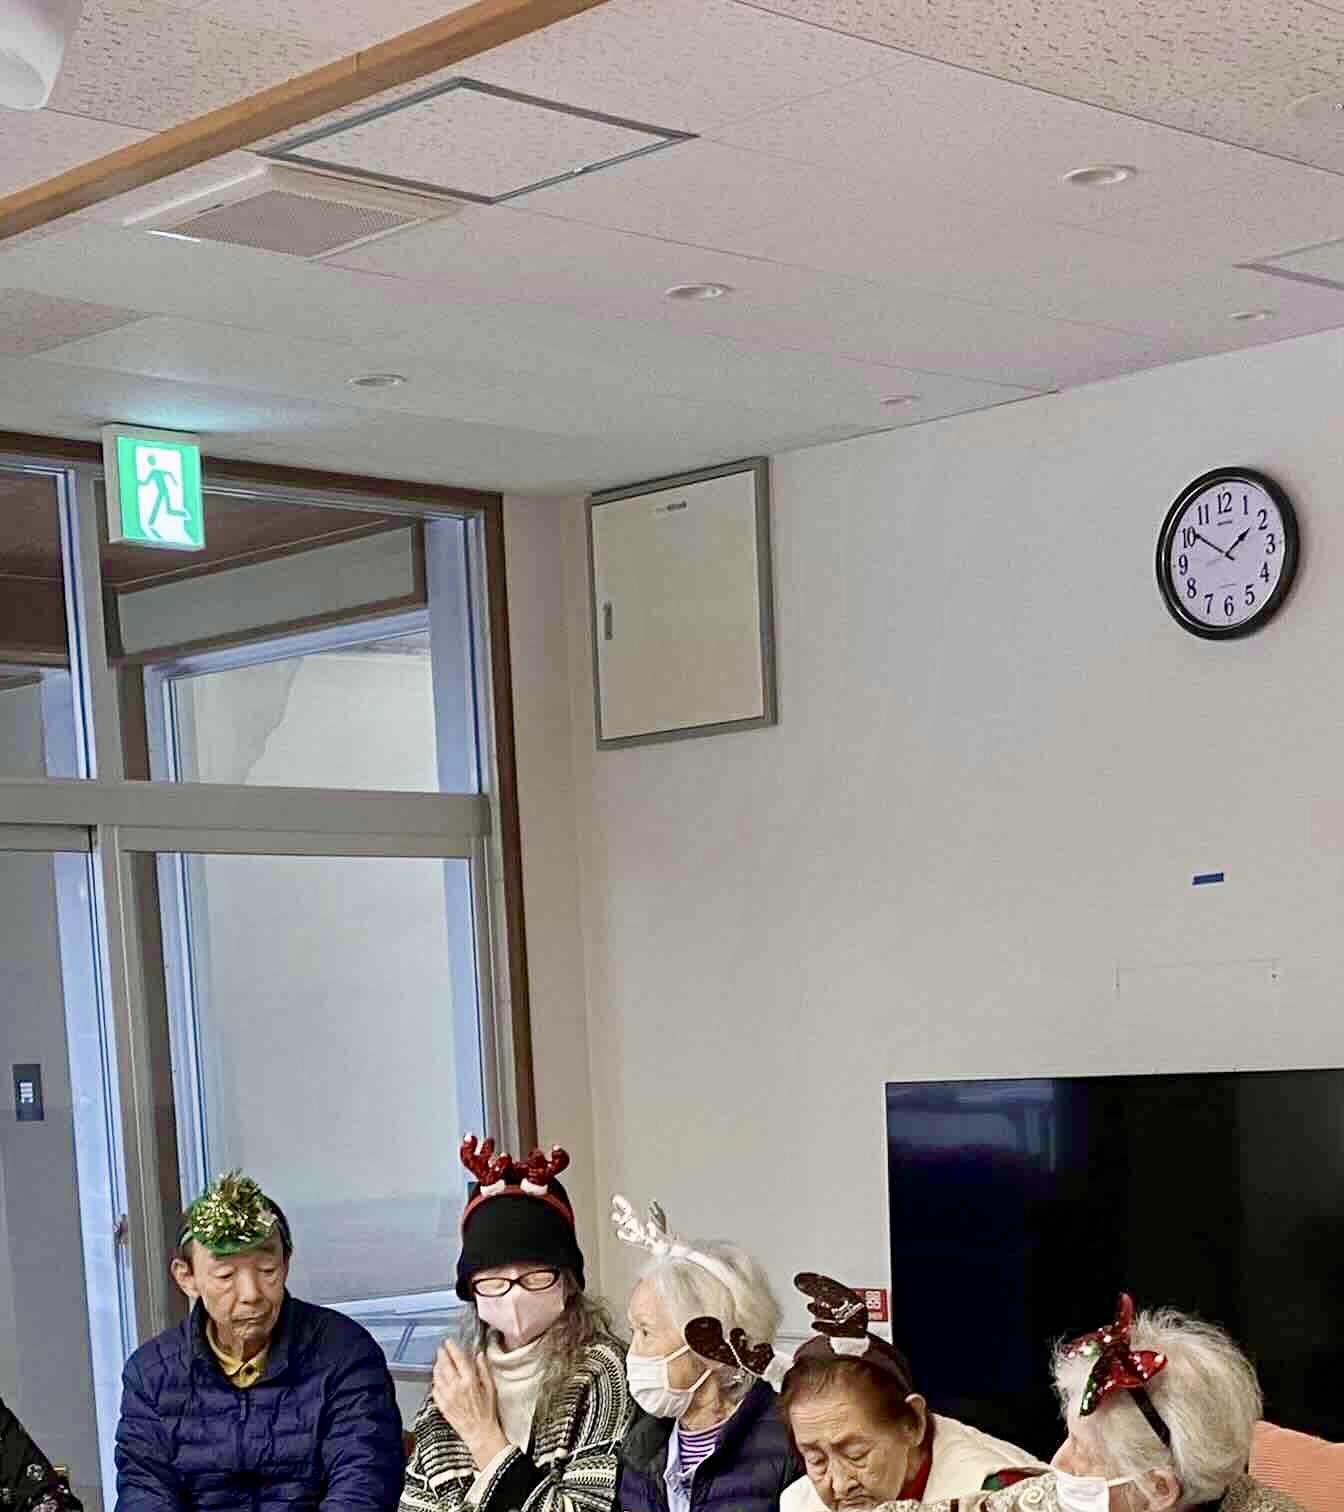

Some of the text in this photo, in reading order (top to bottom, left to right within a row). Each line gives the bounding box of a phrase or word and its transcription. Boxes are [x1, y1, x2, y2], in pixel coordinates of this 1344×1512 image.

[1217, 491, 1233, 515] 12
[1242, 495, 1249, 515] 1
[1197, 503, 1210, 526] 11
[1257, 508, 1268, 530] 2
[1182, 525, 1197, 549] 10
[1265, 533, 1276, 555] 3
[1178, 554, 1189, 576] 9
[1259, 562, 1270, 583] 4
[1186, 577, 1197, 599] 8
[1244, 584, 1255, 606] 5
[1204, 593, 1214, 615] 7
[1223, 595, 1234, 617] 6
